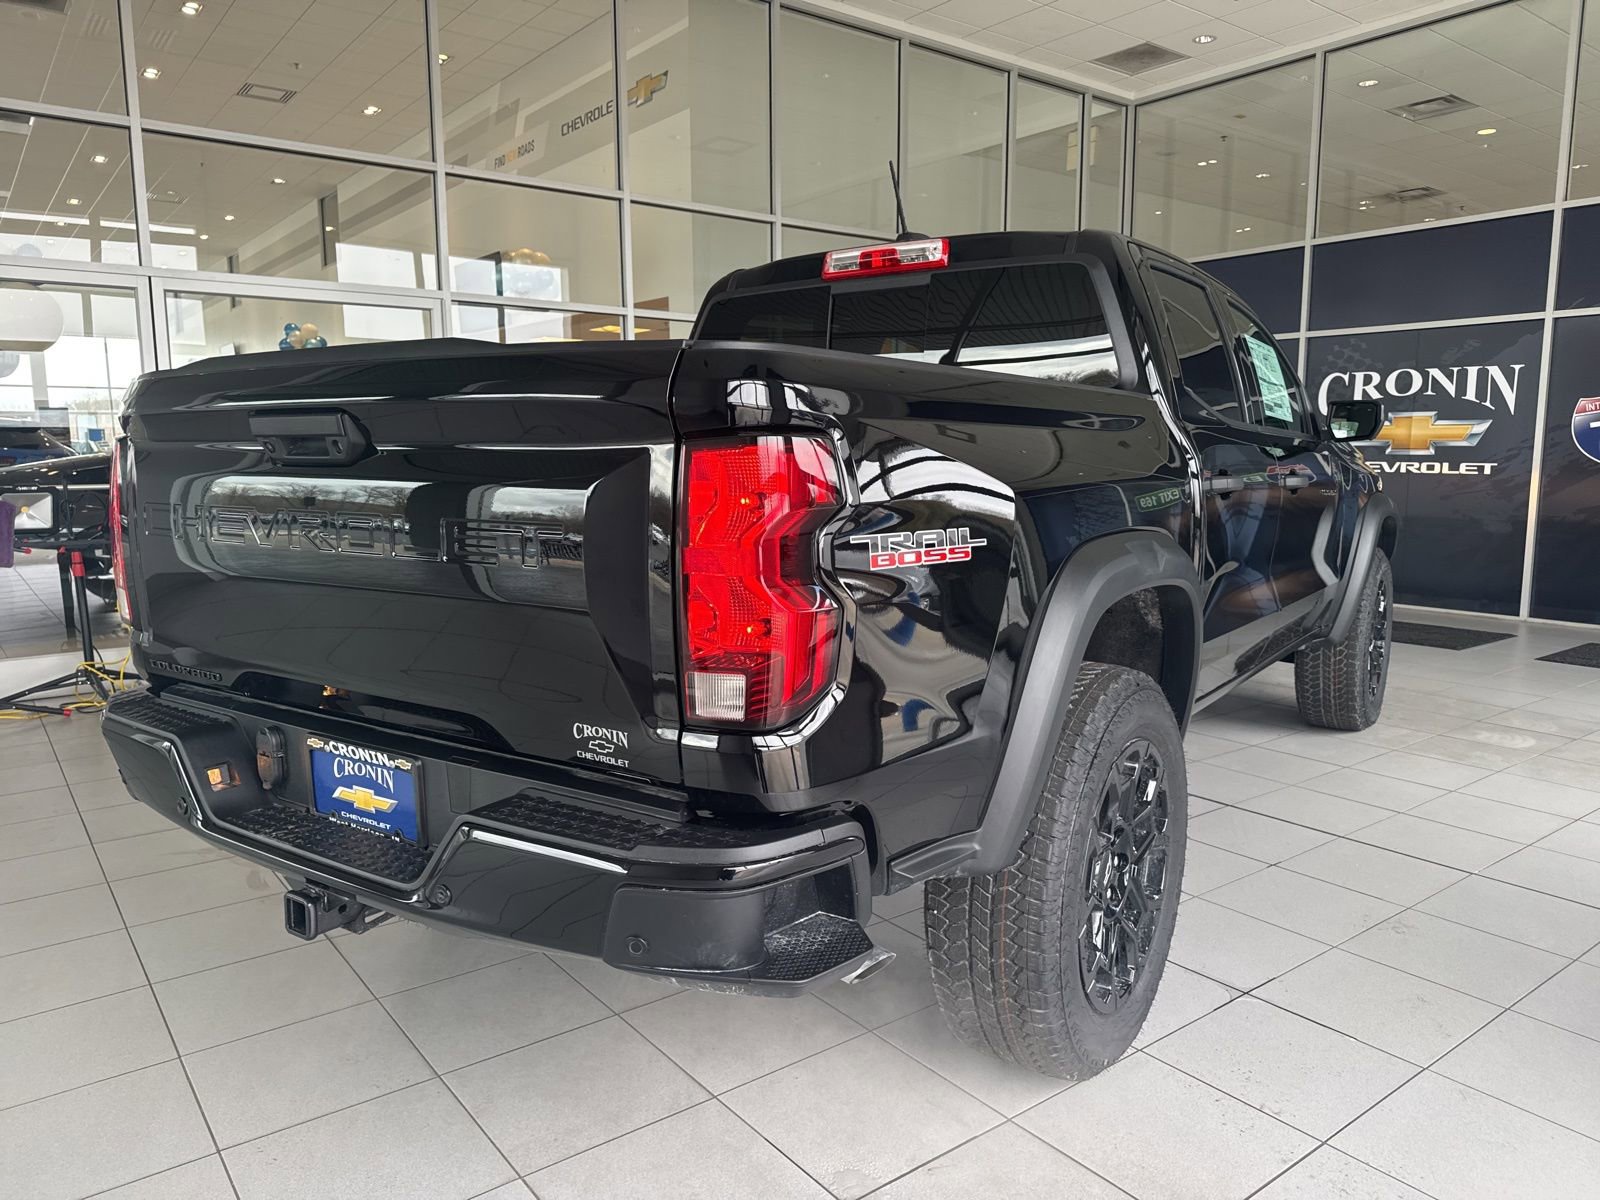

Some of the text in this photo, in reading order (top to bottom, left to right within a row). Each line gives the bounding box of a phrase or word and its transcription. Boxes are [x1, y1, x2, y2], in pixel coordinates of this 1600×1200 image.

[561, 100, 614, 136] CHEVROLE
[517, 139, 535, 159] ROADS
[1318, 364, 1525, 416] CRONIN
[1365, 461, 1498, 475] EVROLET
[144, 502, 564, 569] CHEVROLET
[850, 527, 988, 554] TRAIL
[870, 546, 972, 571] BOSS
[573, 722, 629, 749] CRONIN
[328, 740, 391, 767] CRONIN
[576, 750, 630, 768] CHEVROLET
[333, 757, 394, 794] CRONIN
[341, 811, 391, 830] CHEVROLET
